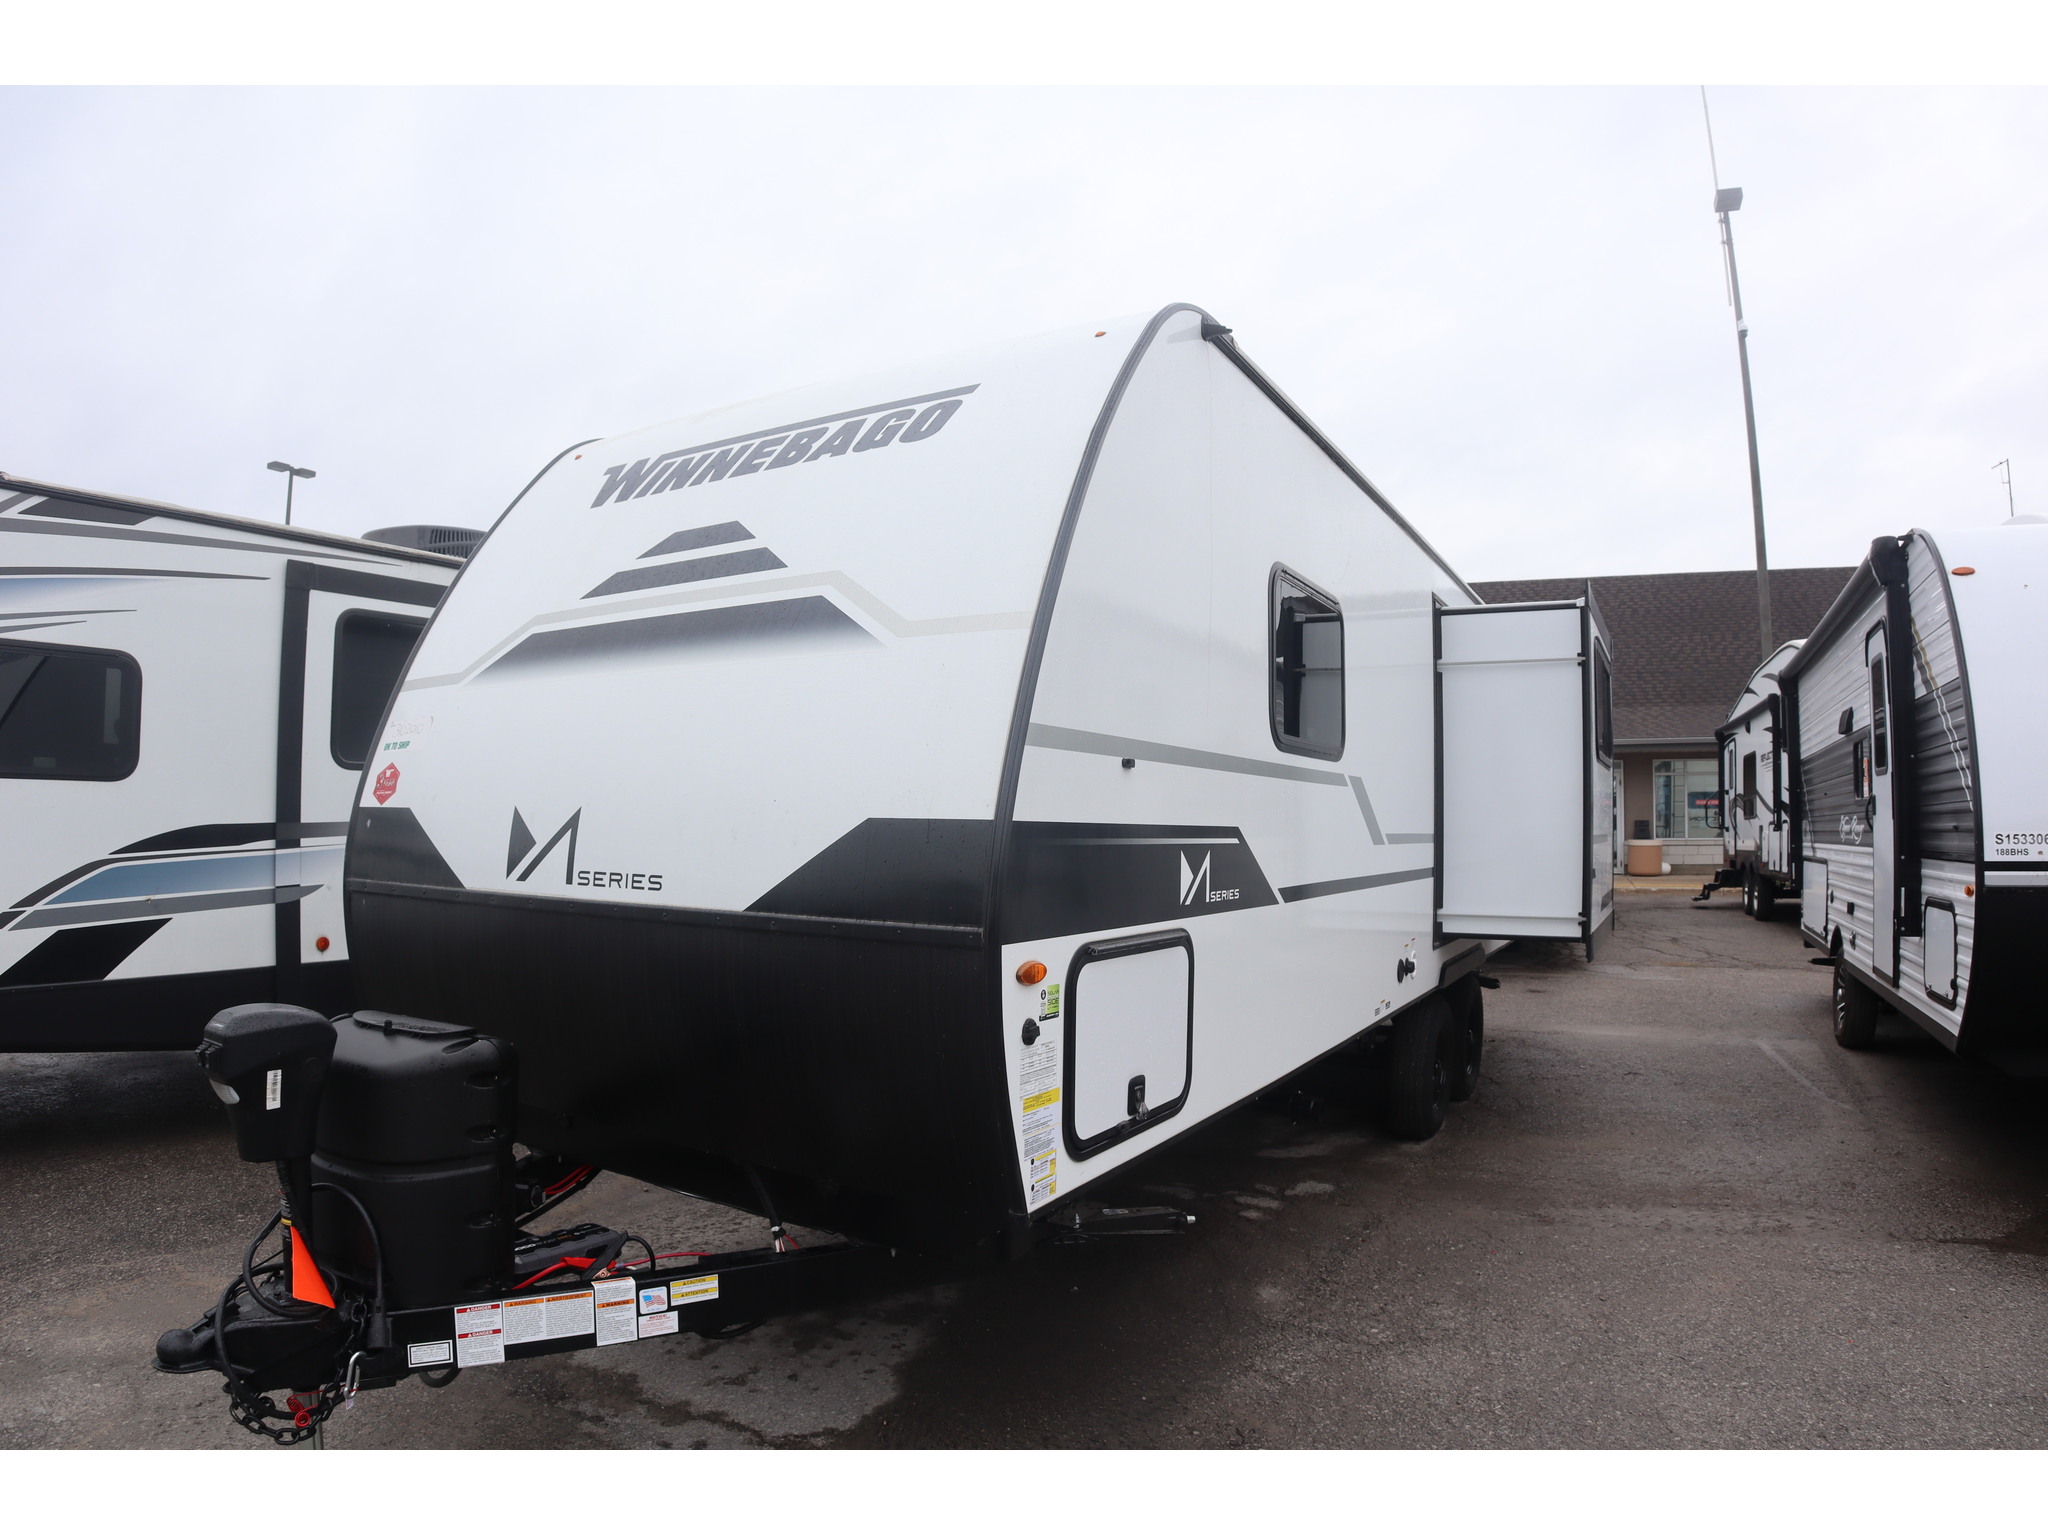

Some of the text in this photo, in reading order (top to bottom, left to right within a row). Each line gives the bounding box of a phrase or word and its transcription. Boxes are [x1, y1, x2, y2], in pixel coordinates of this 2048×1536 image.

[590, 398, 964, 509] WINNEBAGO
[391, 742, 398, 750] TO
[398, 741, 410, 750] SHIP
[1995, 848, 2029, 856] 188BHS
[577, 870, 663, 891] SERIES
[1210, 888, 1240, 902] SERIES
[685, 1289, 709, 1297] ATTENTION
